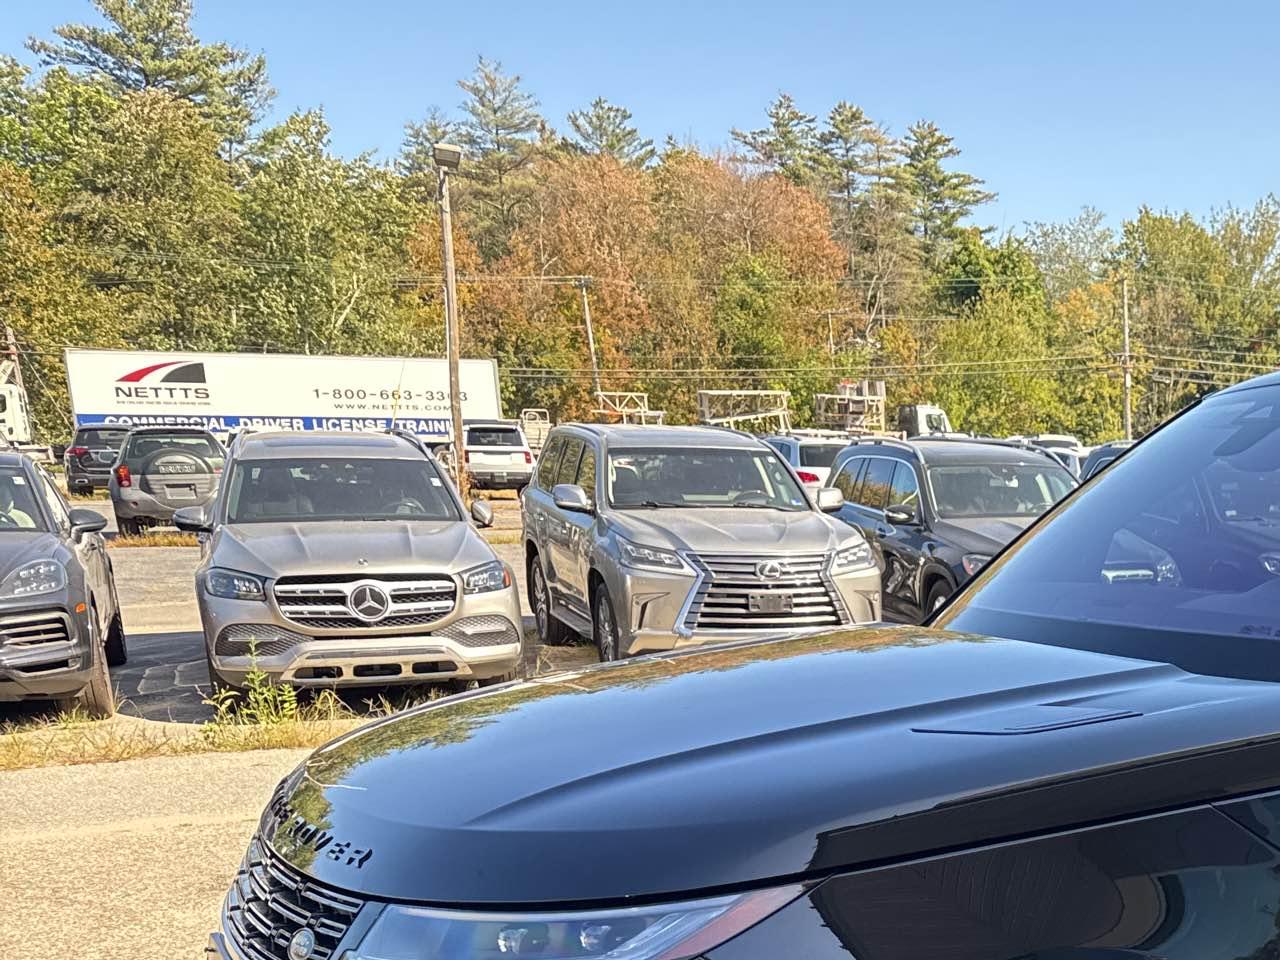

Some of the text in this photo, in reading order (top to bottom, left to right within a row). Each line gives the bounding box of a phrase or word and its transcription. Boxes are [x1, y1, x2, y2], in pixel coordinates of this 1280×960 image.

[114, 386, 210, 399] NETTTS
[313, 388, 468, 401] 1-800-663-333
[239, 418, 305, 431] DRIVER
[312, 418, 387, 432] LICENSE
